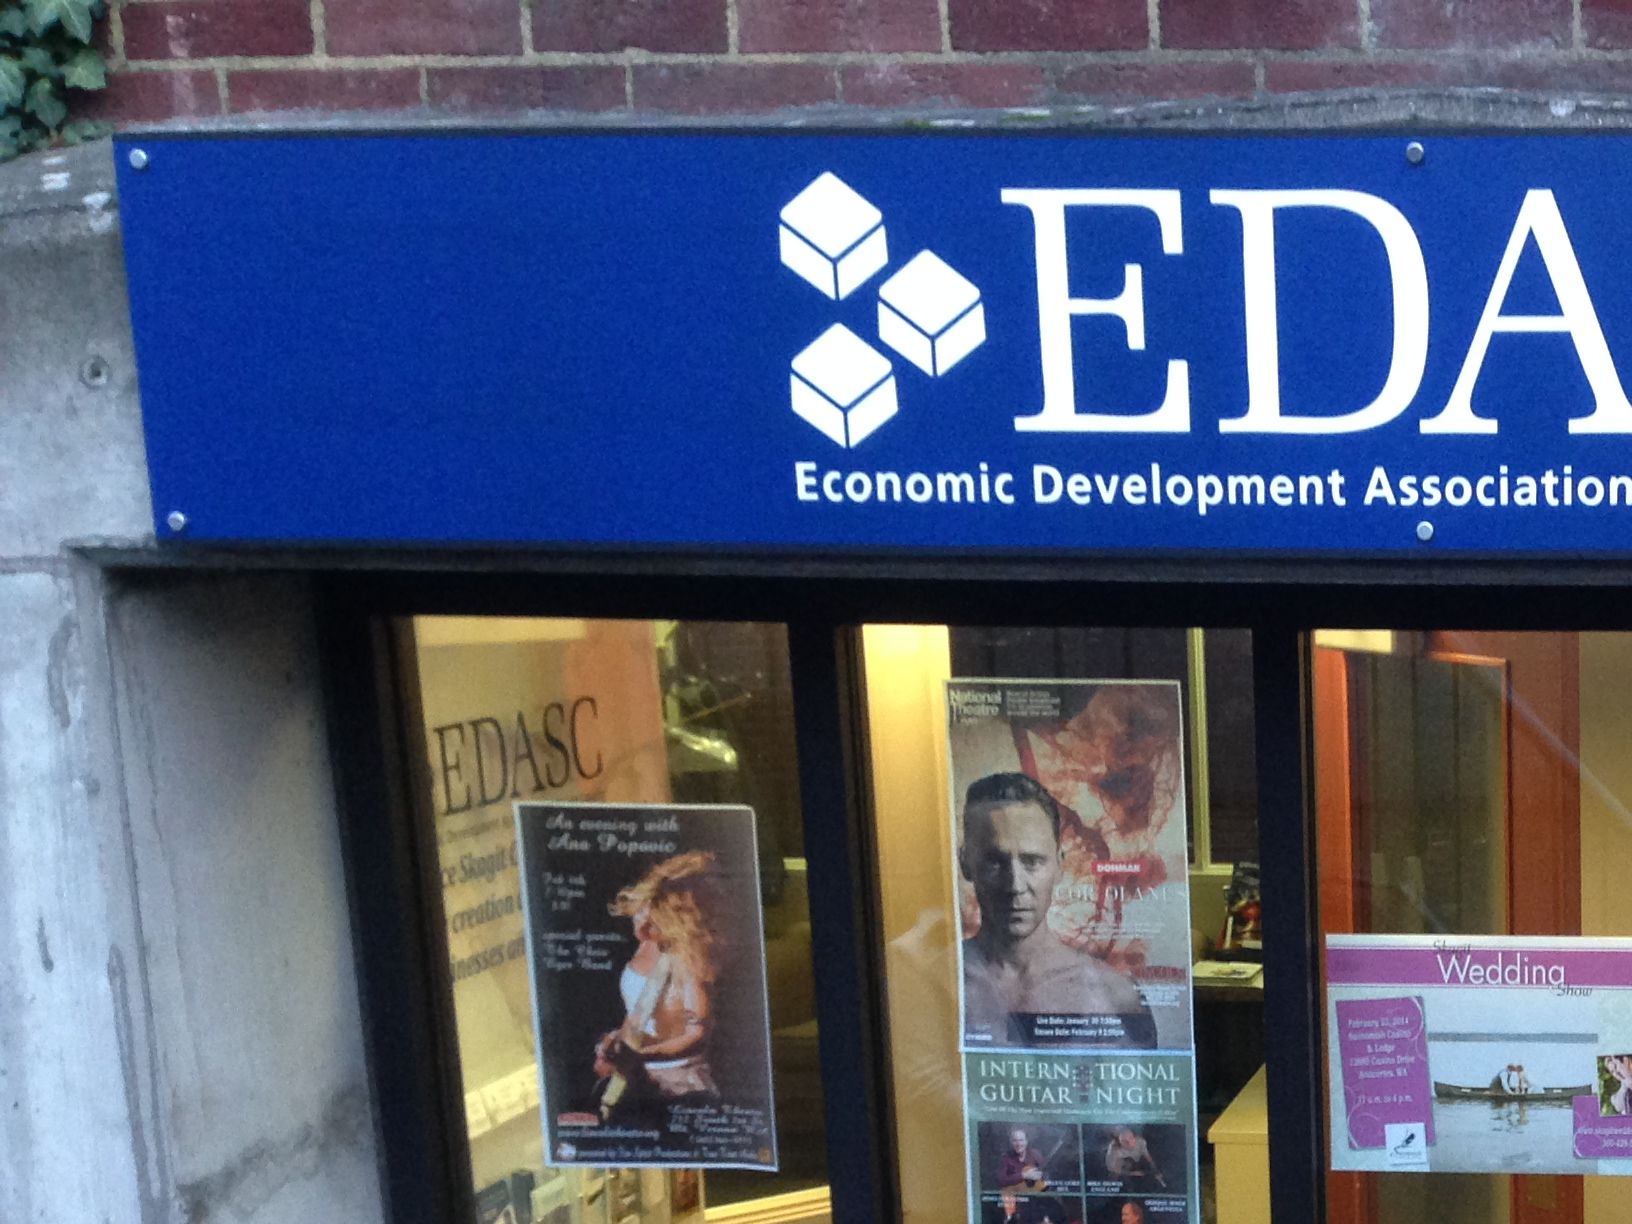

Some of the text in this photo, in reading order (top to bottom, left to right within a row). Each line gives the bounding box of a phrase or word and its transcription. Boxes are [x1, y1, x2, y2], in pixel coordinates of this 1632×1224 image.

[794, 461, 1015, 506] Economic
[1034, 464, 1347, 514] Development
[434, 696, 604, 817] EDASC
[644, 815, 680, 832] with
[1436, 951, 1565, 985] Wedding
[1551, 982, 1593, 997] Show
[979, 1059, 1180, 1082] INTERNTIONAL
[979, 1083, 1181, 1106] GUITAR NIGHT
